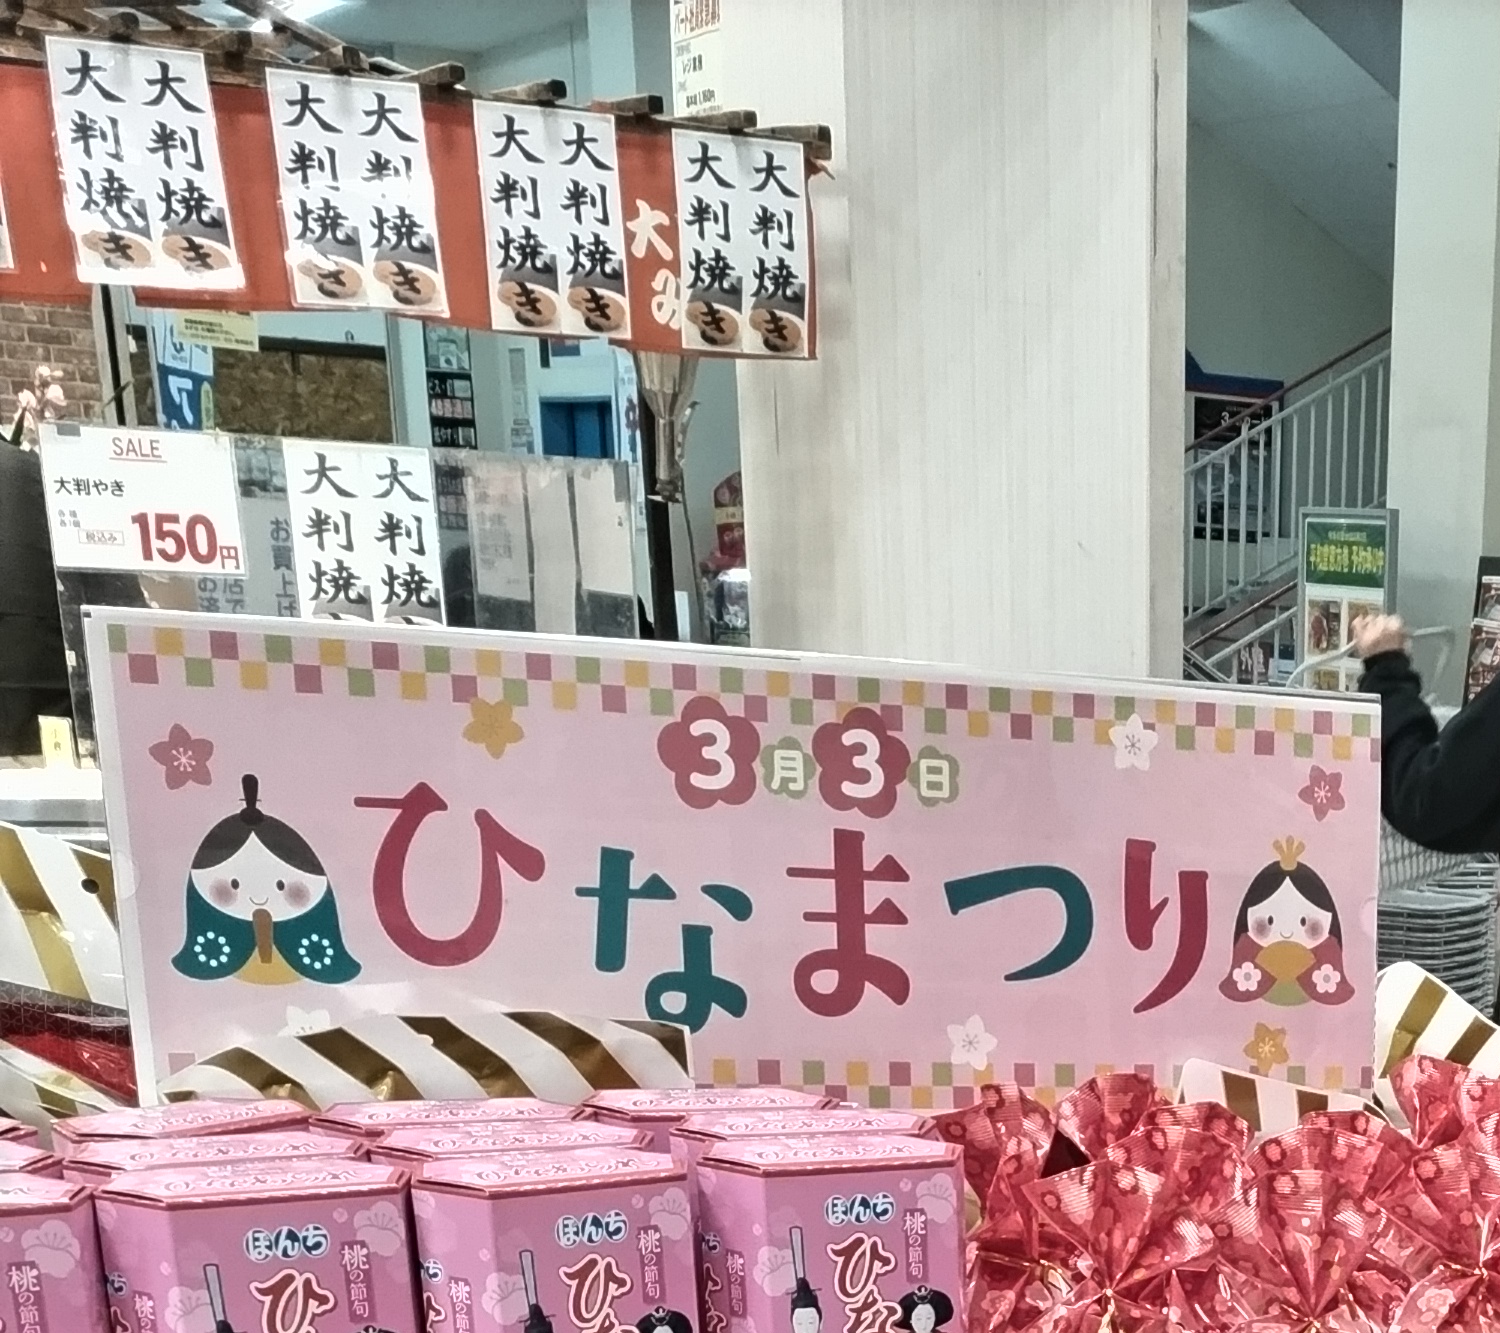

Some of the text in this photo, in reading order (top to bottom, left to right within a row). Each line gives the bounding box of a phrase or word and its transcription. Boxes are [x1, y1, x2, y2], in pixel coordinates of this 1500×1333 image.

[141, 59, 223, 272] 大判焼き
[488, 113, 554, 328] 大判焼き
[559, 121, 623, 332] 大判焼き
[684, 140, 742, 349] 大判焼き
[749, 150, 806, 353] 大判焼き
[112, 436, 162, 459] SALE
[53, 476, 126, 498] 大判やき
[688, 718, 950, 800] 3月3日
[354, 781, 1210, 1034] ひなまつり
[245, 1225, 329, 1260] ほんち
[555, 1210, 627, 1245] ほんち
[825, 1192, 895, 1226] ほんち
[902, 1210, 927, 1278] 桃の節句
[342, 1241, 373, 1318] 桃の節句
[637, 1229, 664, 1300] 桃の節句
